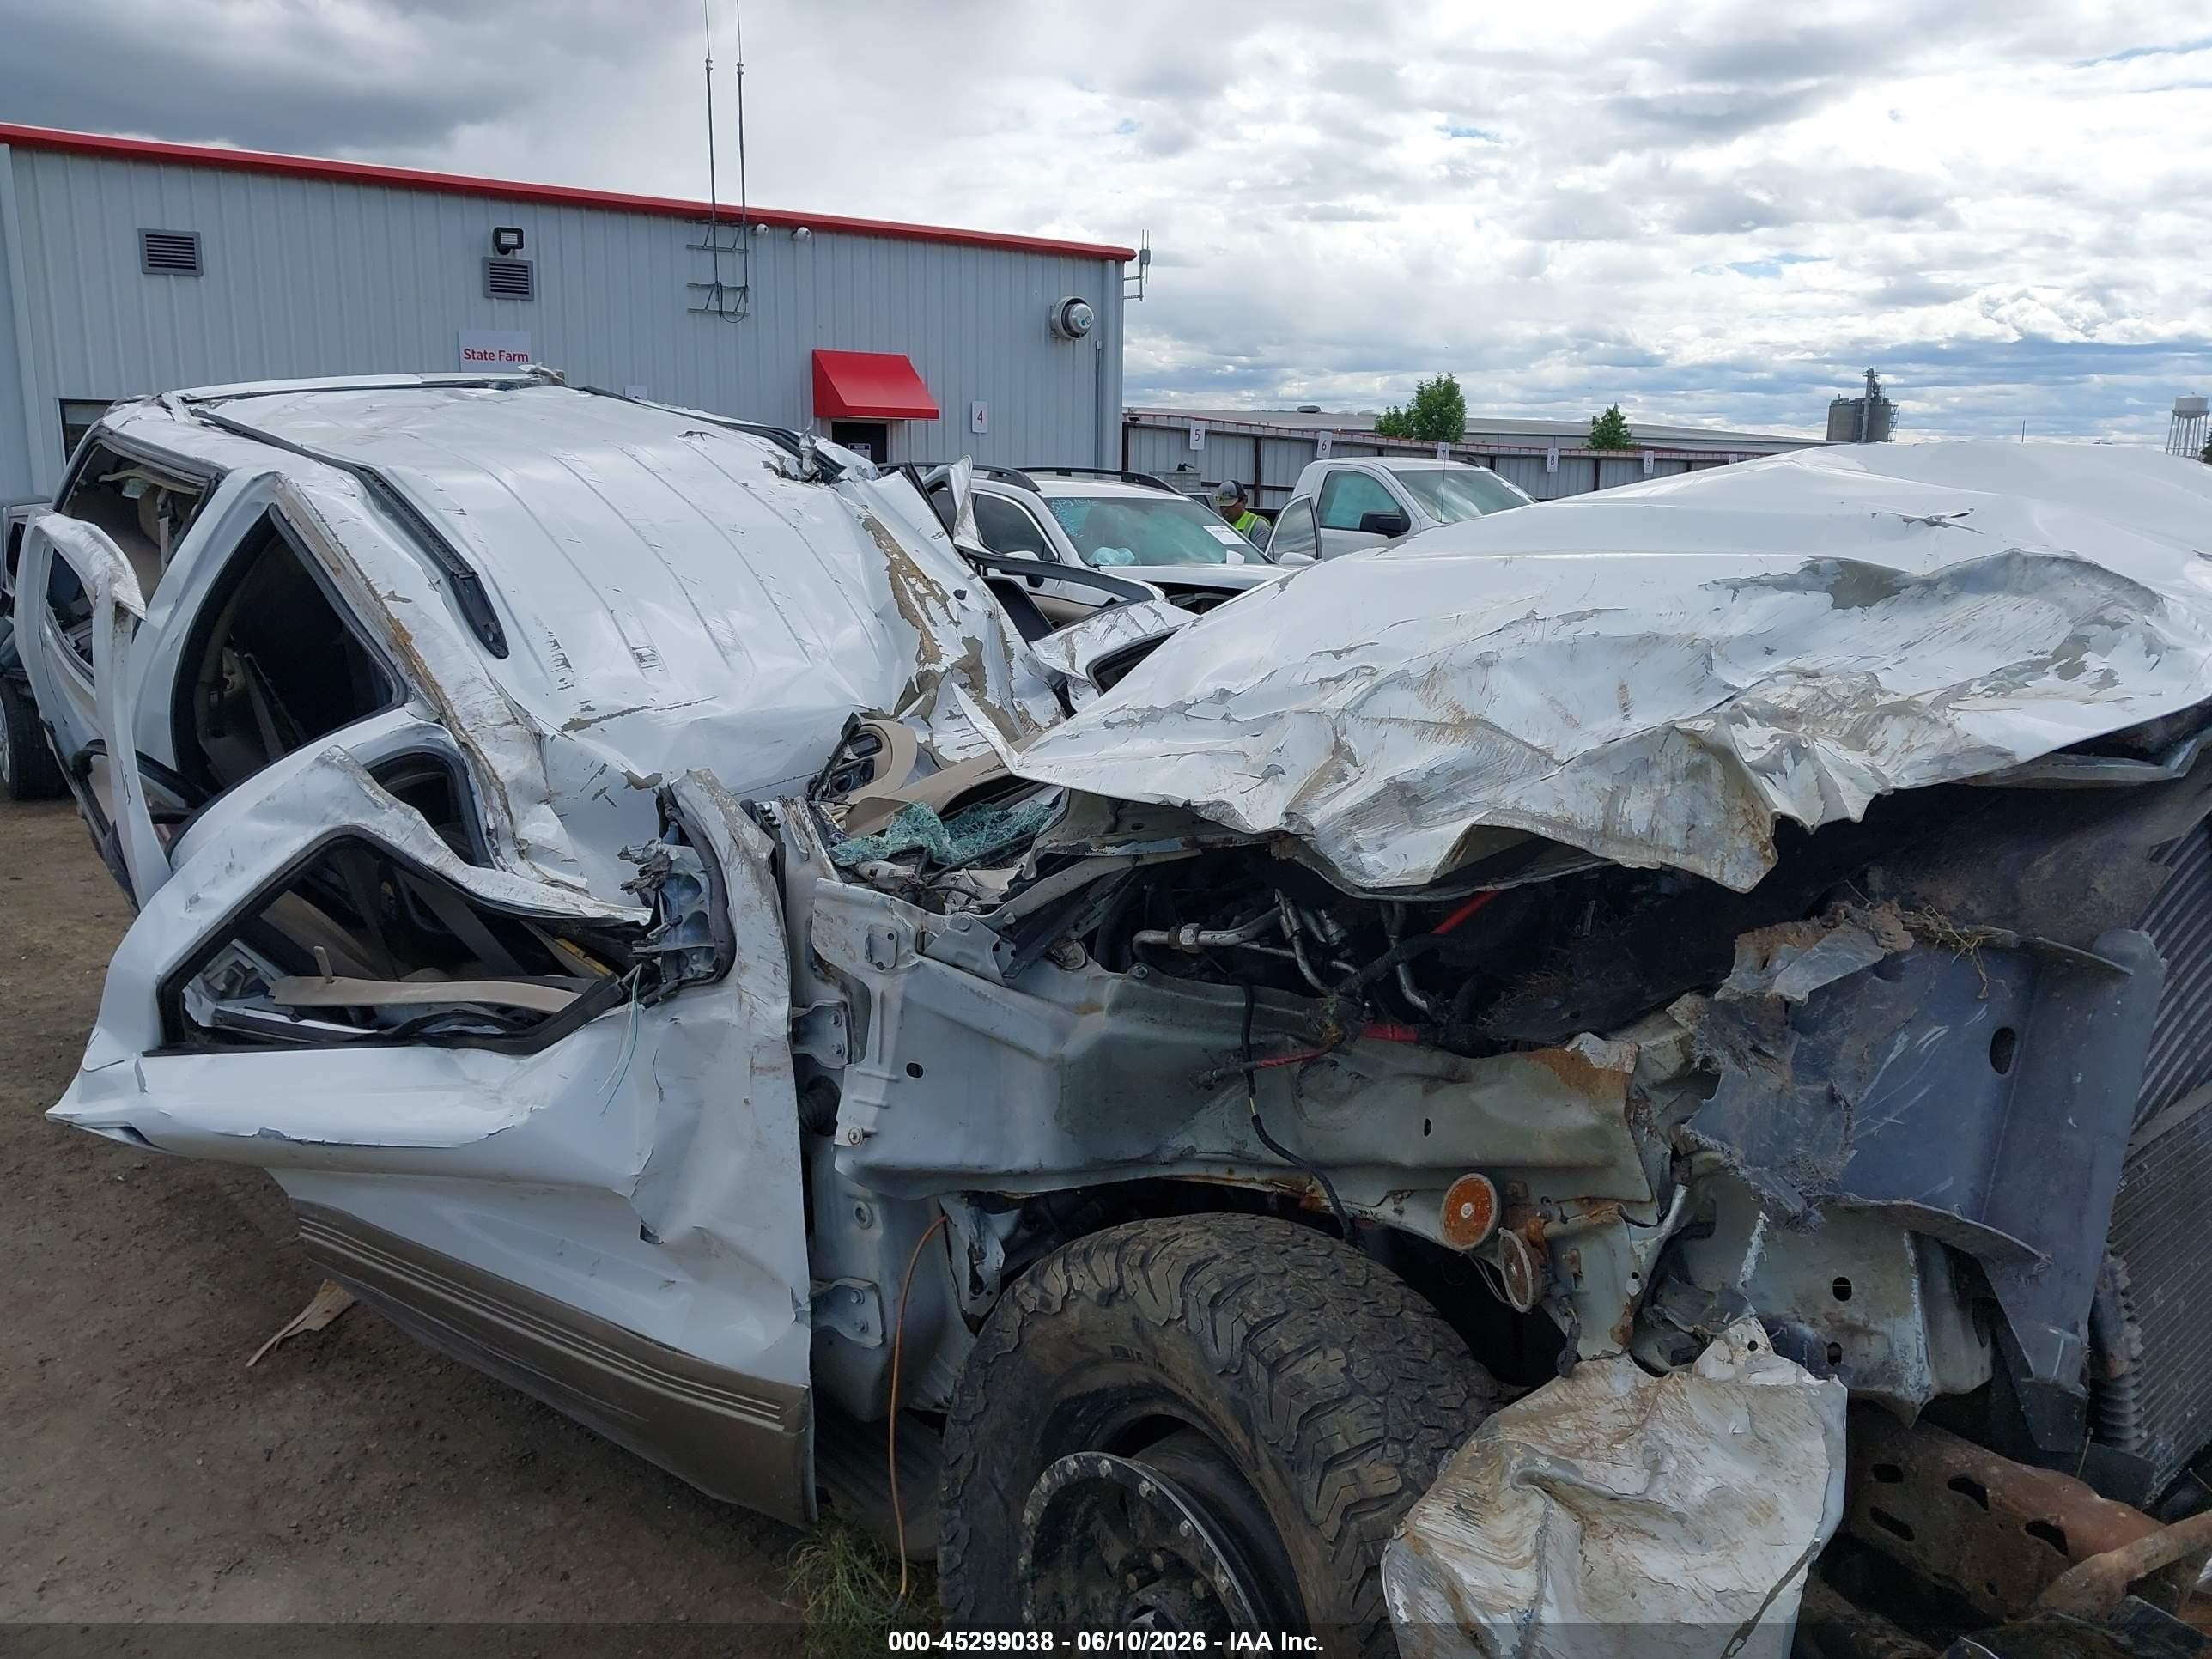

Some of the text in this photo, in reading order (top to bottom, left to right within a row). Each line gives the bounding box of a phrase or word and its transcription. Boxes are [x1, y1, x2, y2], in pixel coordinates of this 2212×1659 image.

[463, 348, 529, 362] State Farm
[976, 410, 983, 424] 4
[1194, 428, 1200, 441] 5
[1322, 438, 1328, 451] 6
[1550, 454, 1555, 465] 8
